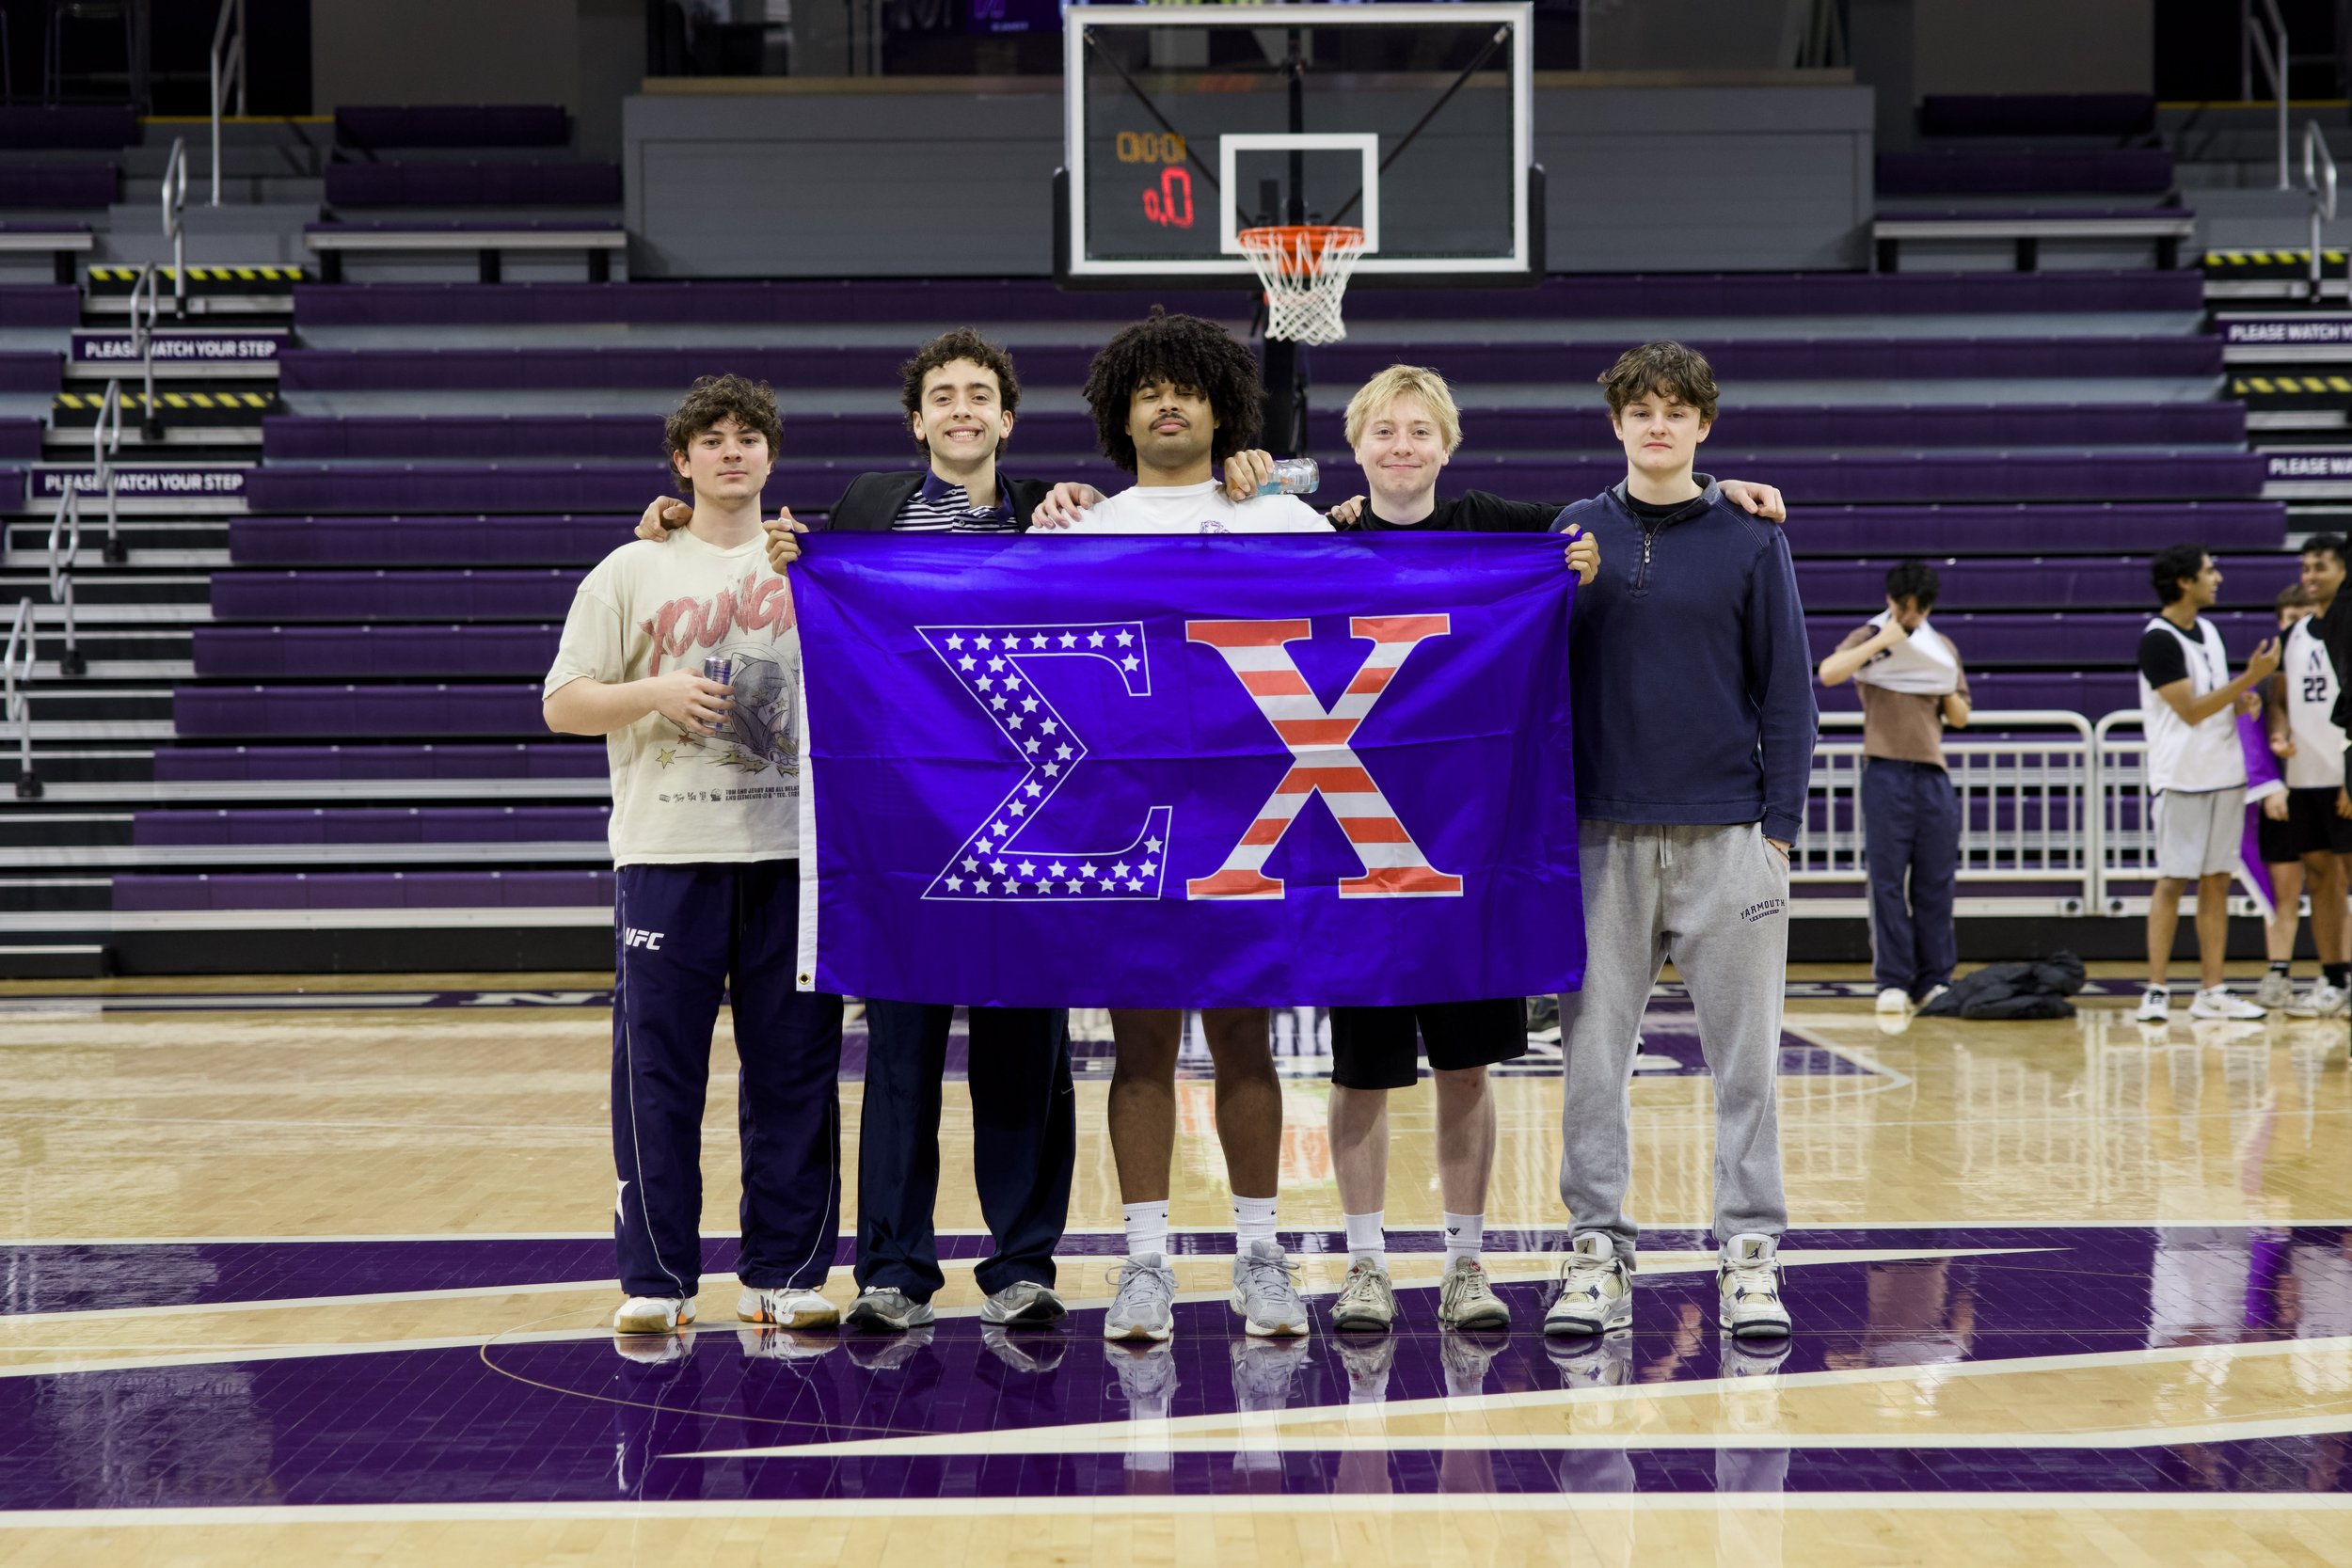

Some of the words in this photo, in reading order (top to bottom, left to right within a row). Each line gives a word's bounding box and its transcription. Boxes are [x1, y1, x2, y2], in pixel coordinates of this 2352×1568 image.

[2229, 324, 2287, 340] PLEASE
[2288, 324, 2341, 340] WATCH
[85, 340, 137, 358] PLEAS
[196, 340, 237, 357] YOUR
[237, 340, 277, 357] STEP
[2268, 457, 2328, 475] PLEASE
[113, 473, 160, 491] ATCH
[160, 473, 202, 491] YOUR
[203, 473, 244, 491] STEP
[2303, 676, 2328, 702] 22
[1740, 898, 1786, 920] YARMOUTH
[626, 927, 665, 951] UFC
